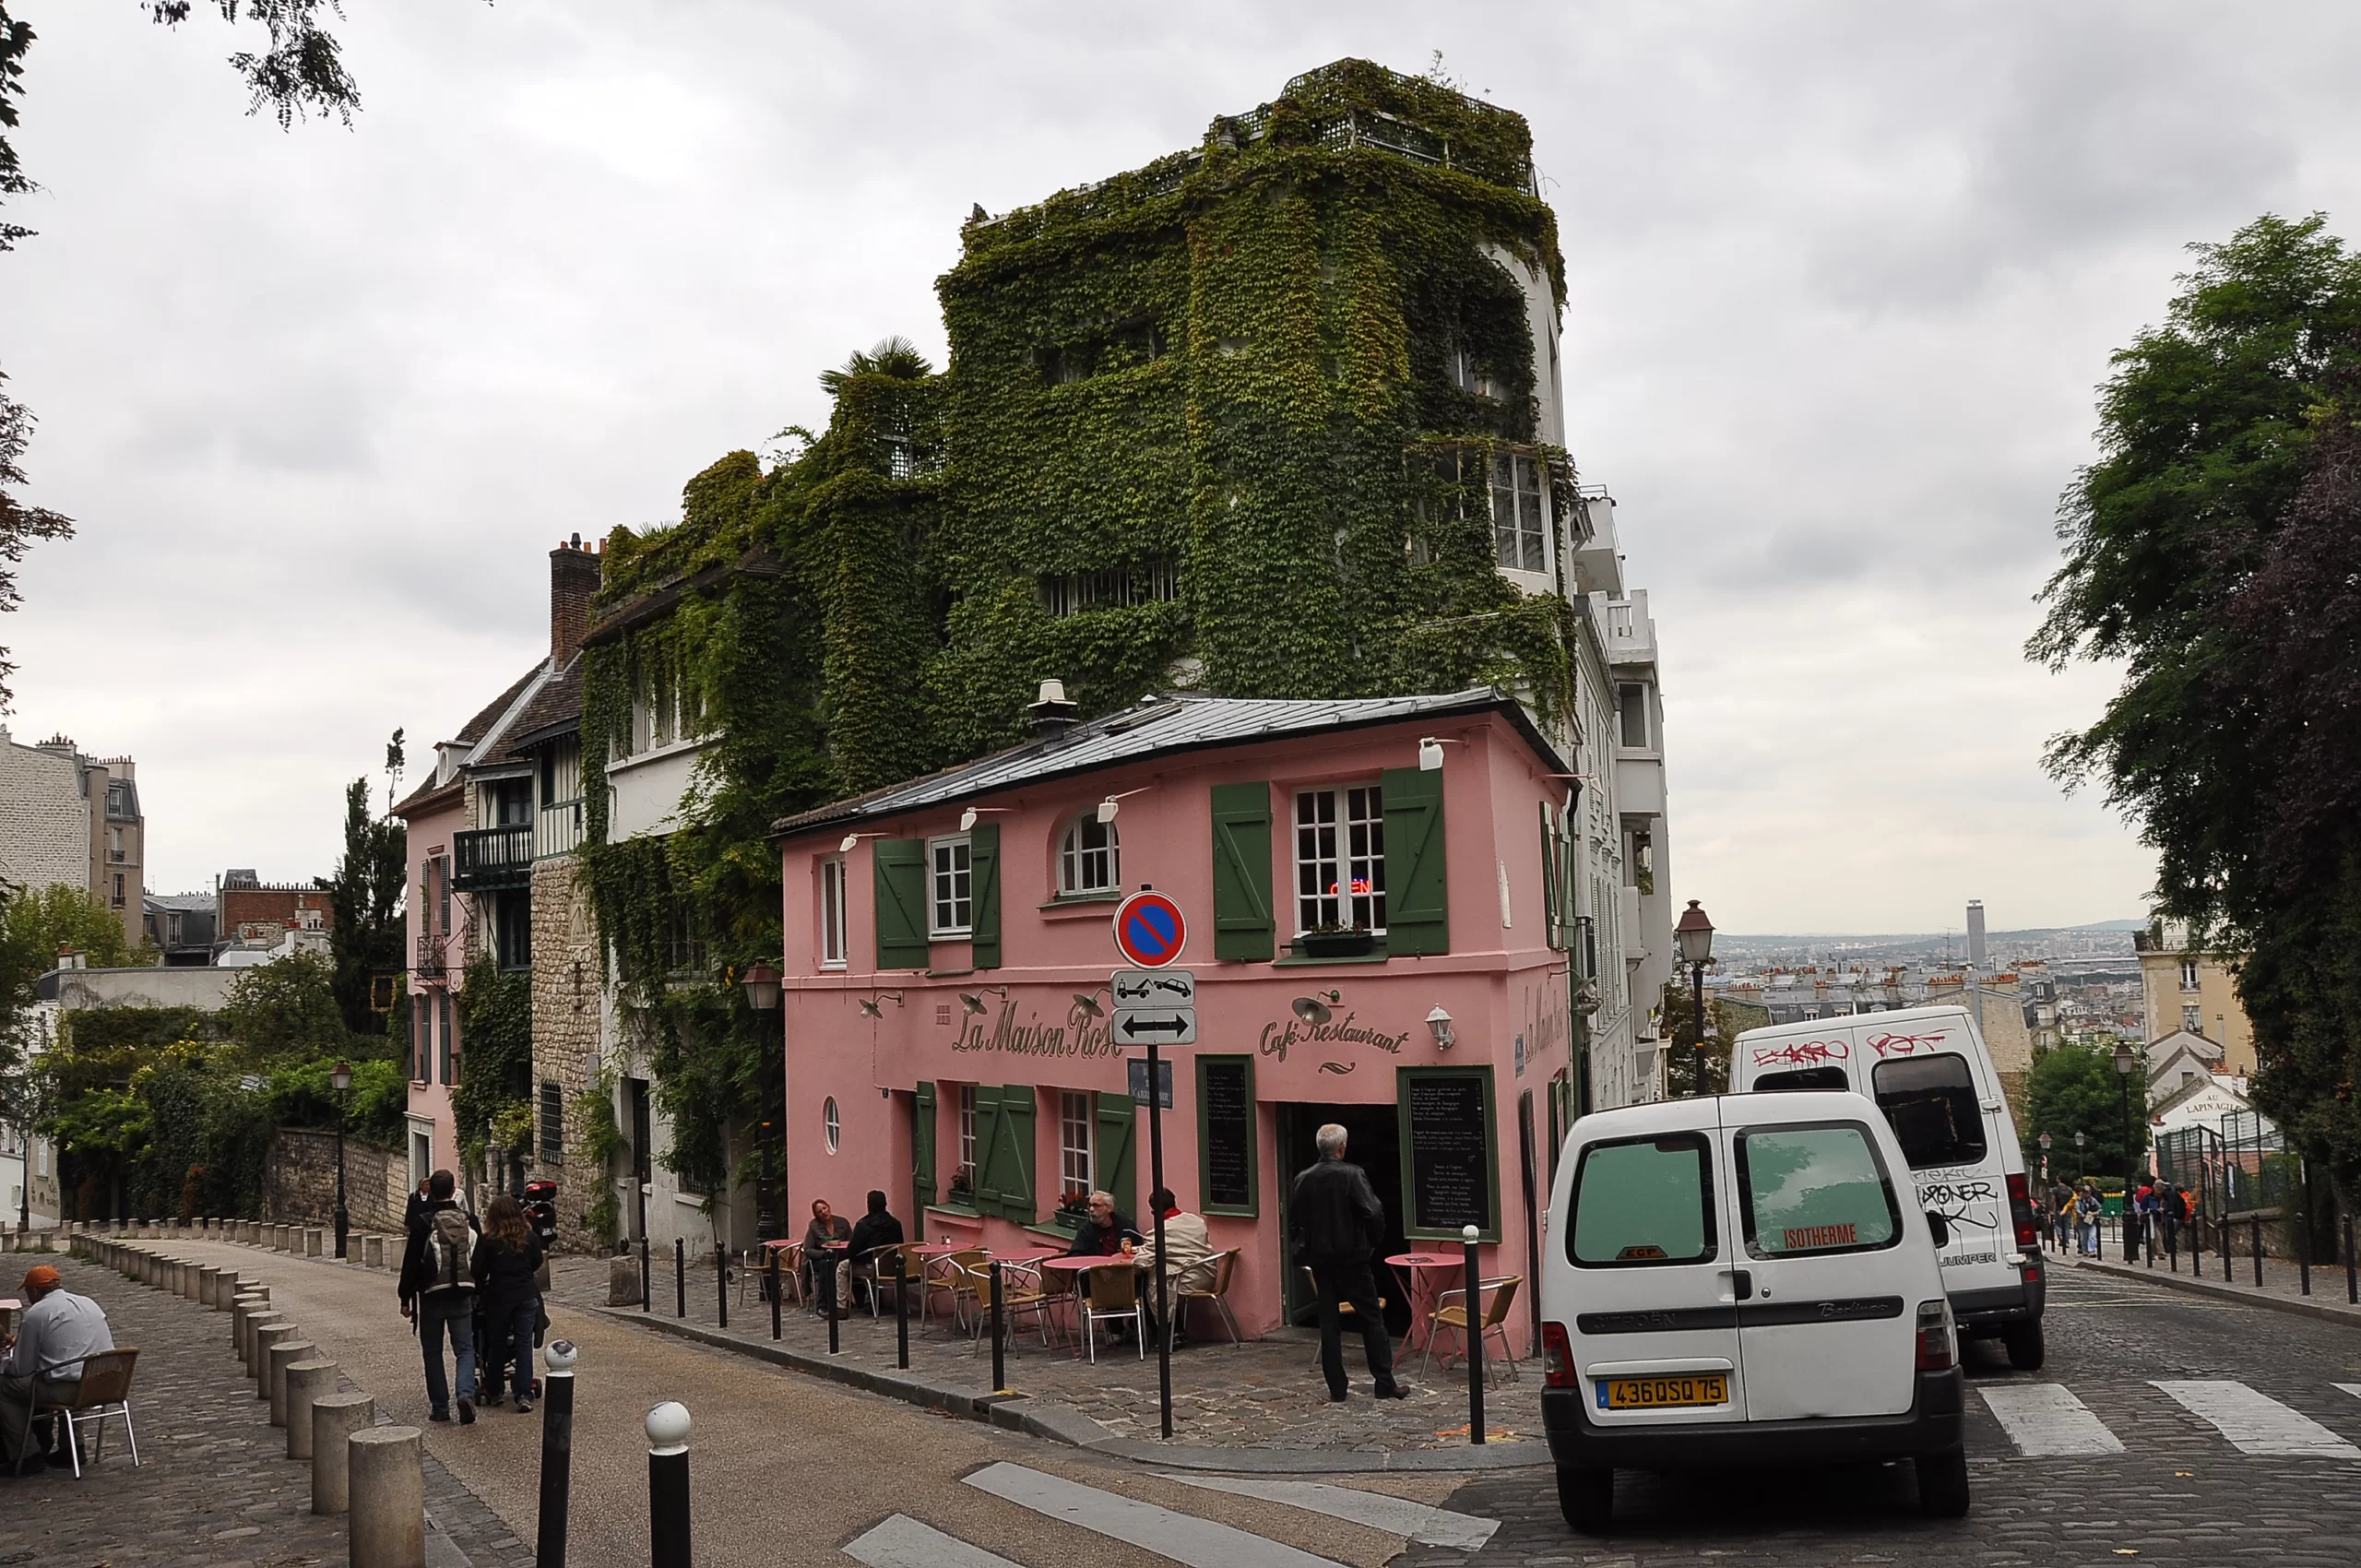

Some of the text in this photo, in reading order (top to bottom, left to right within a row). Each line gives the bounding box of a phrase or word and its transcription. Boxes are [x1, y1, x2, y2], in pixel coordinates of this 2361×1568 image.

[1330, 880, 1370, 895] OEN
[952, 1013, 985, 1052] La
[986, 1001, 1066, 1057] Maison
[1260, 1011, 1410, 1063] Café Restaurant
[2186, 1103, 2213, 1114] LAPIN
[1784, 1224, 1857, 1249] ISOTHERME
[1940, 1253, 1997, 1267] JUMPER
[1817, 1301, 1888, 1317] Berlingo
